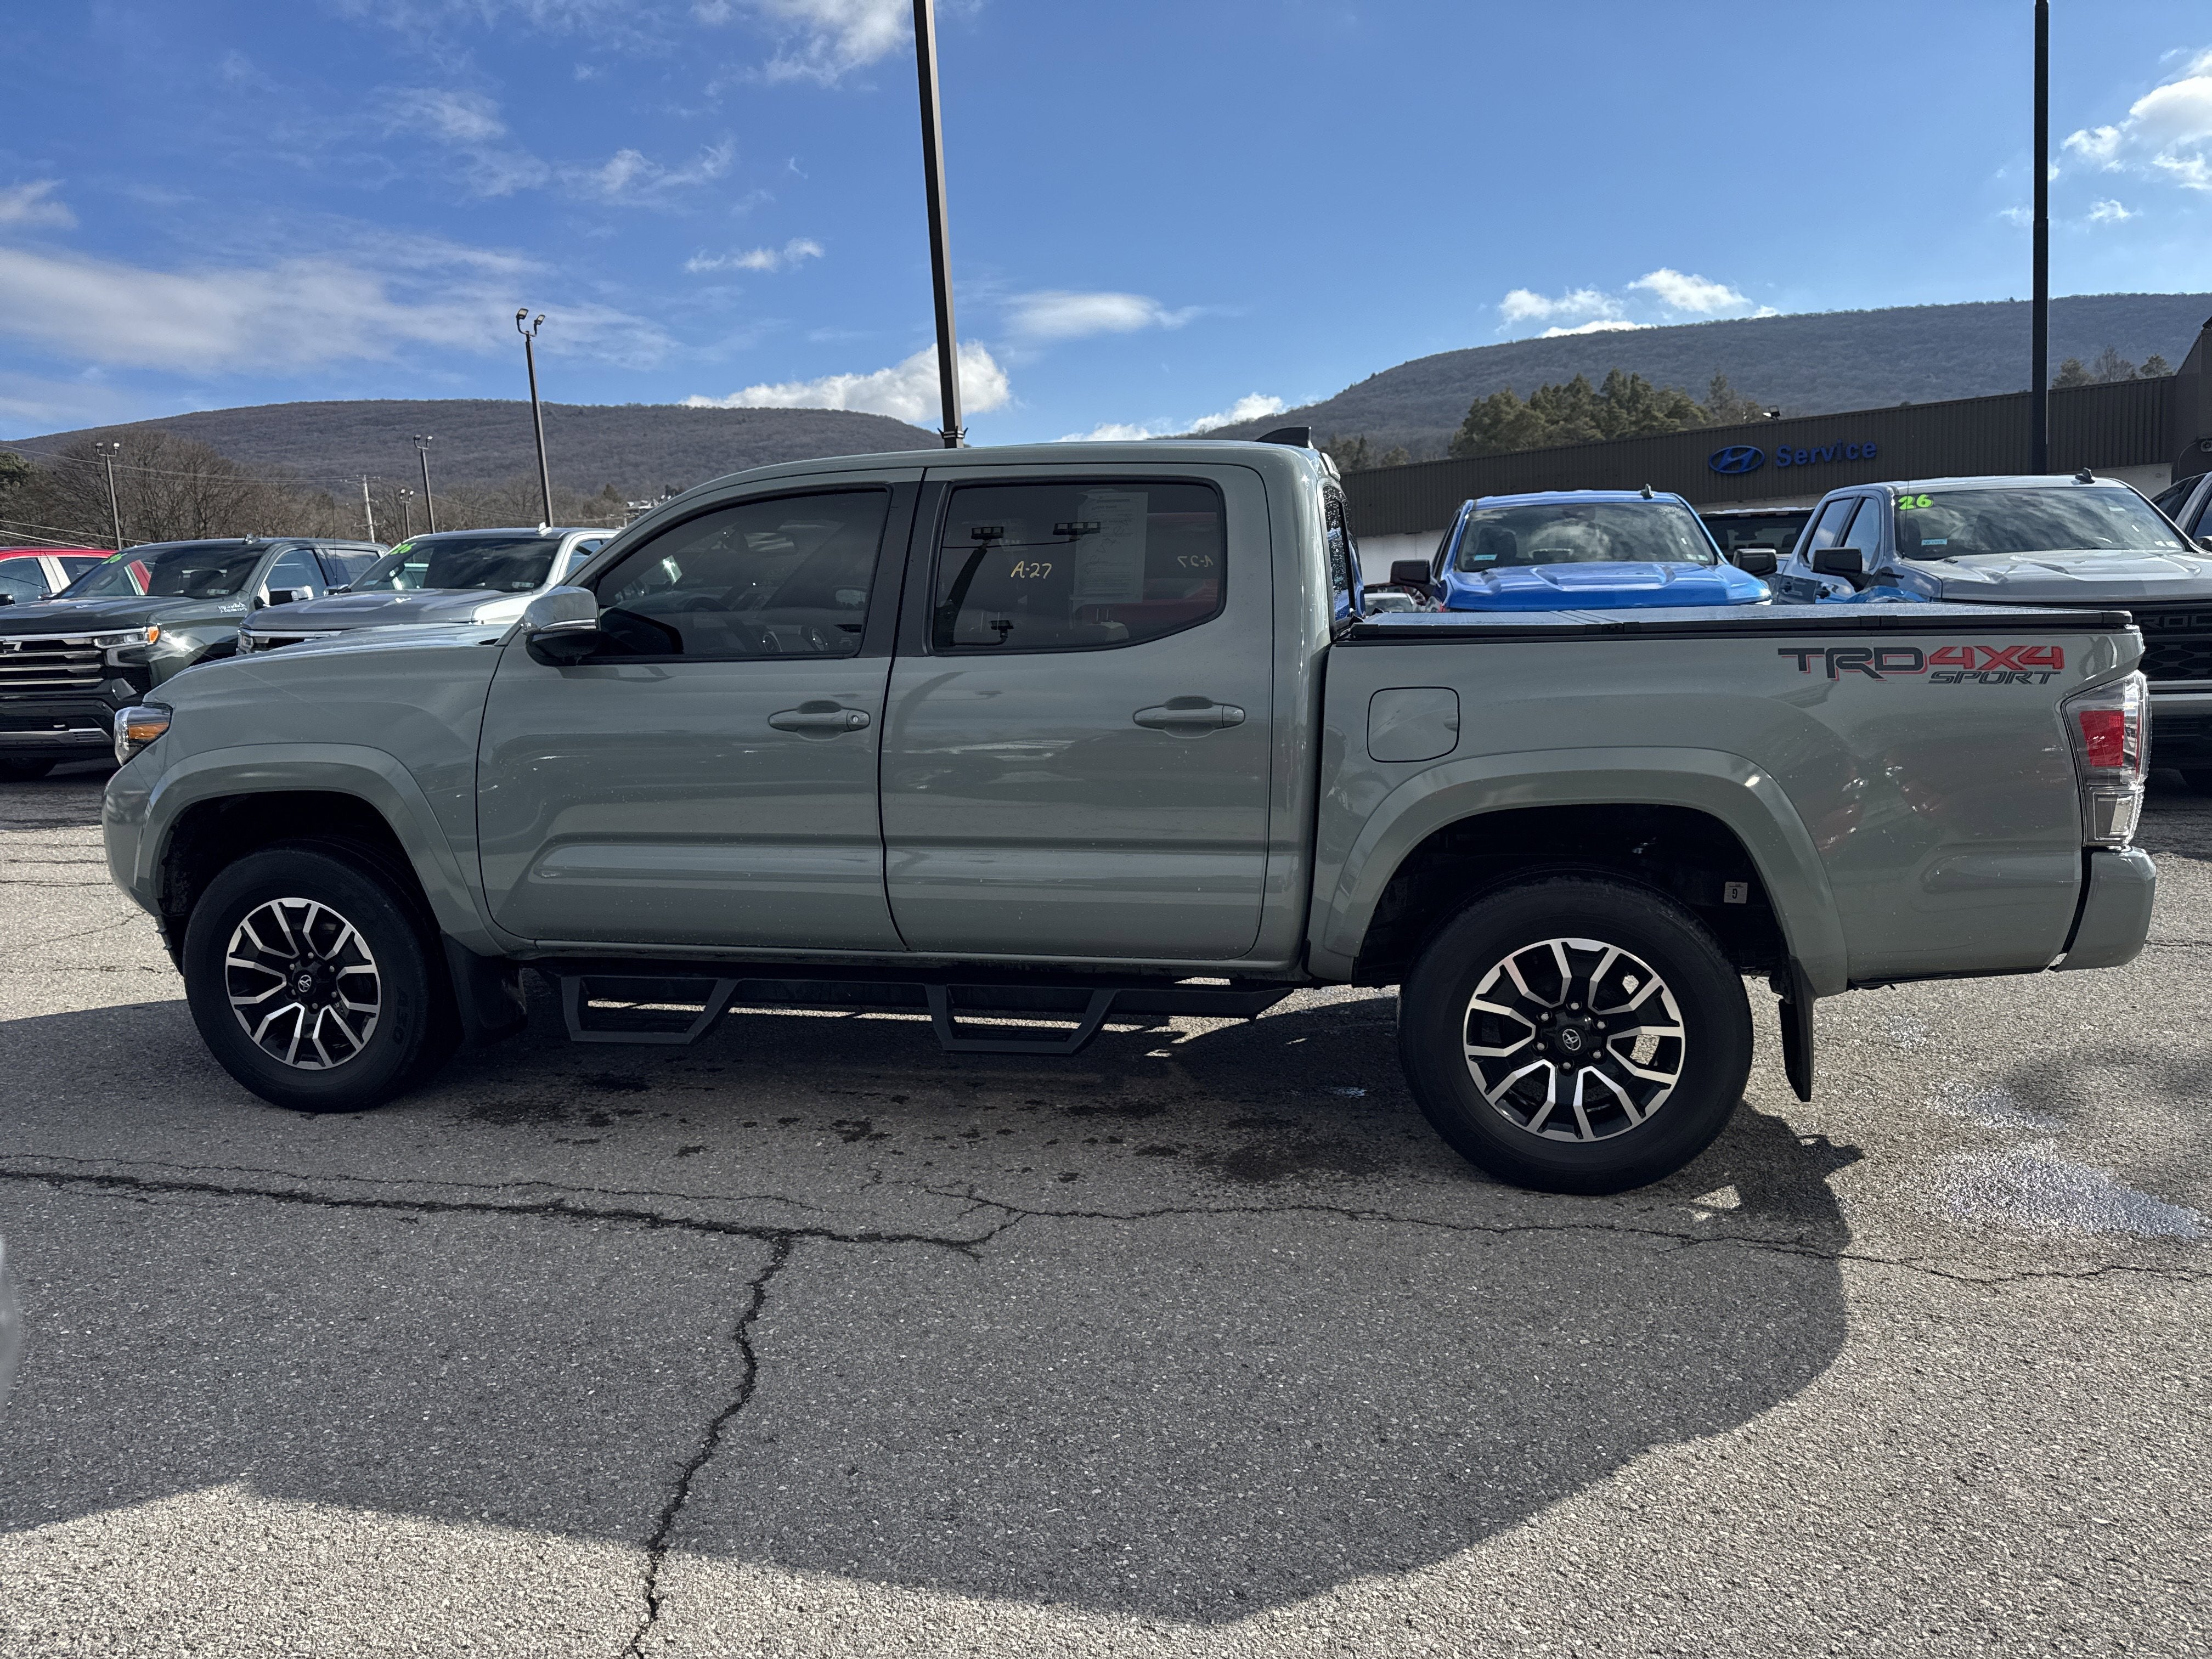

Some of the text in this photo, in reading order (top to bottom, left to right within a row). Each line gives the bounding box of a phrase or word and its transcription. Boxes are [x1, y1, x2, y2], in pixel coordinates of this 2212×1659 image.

[1775, 439, 1877, 466] Service
[1898, 494, 1934, 510] 26
[1011, 560, 1052, 579] A-27
[1778, 647, 1928, 682] TRD
[1928, 670, 2061, 685] SPORT
